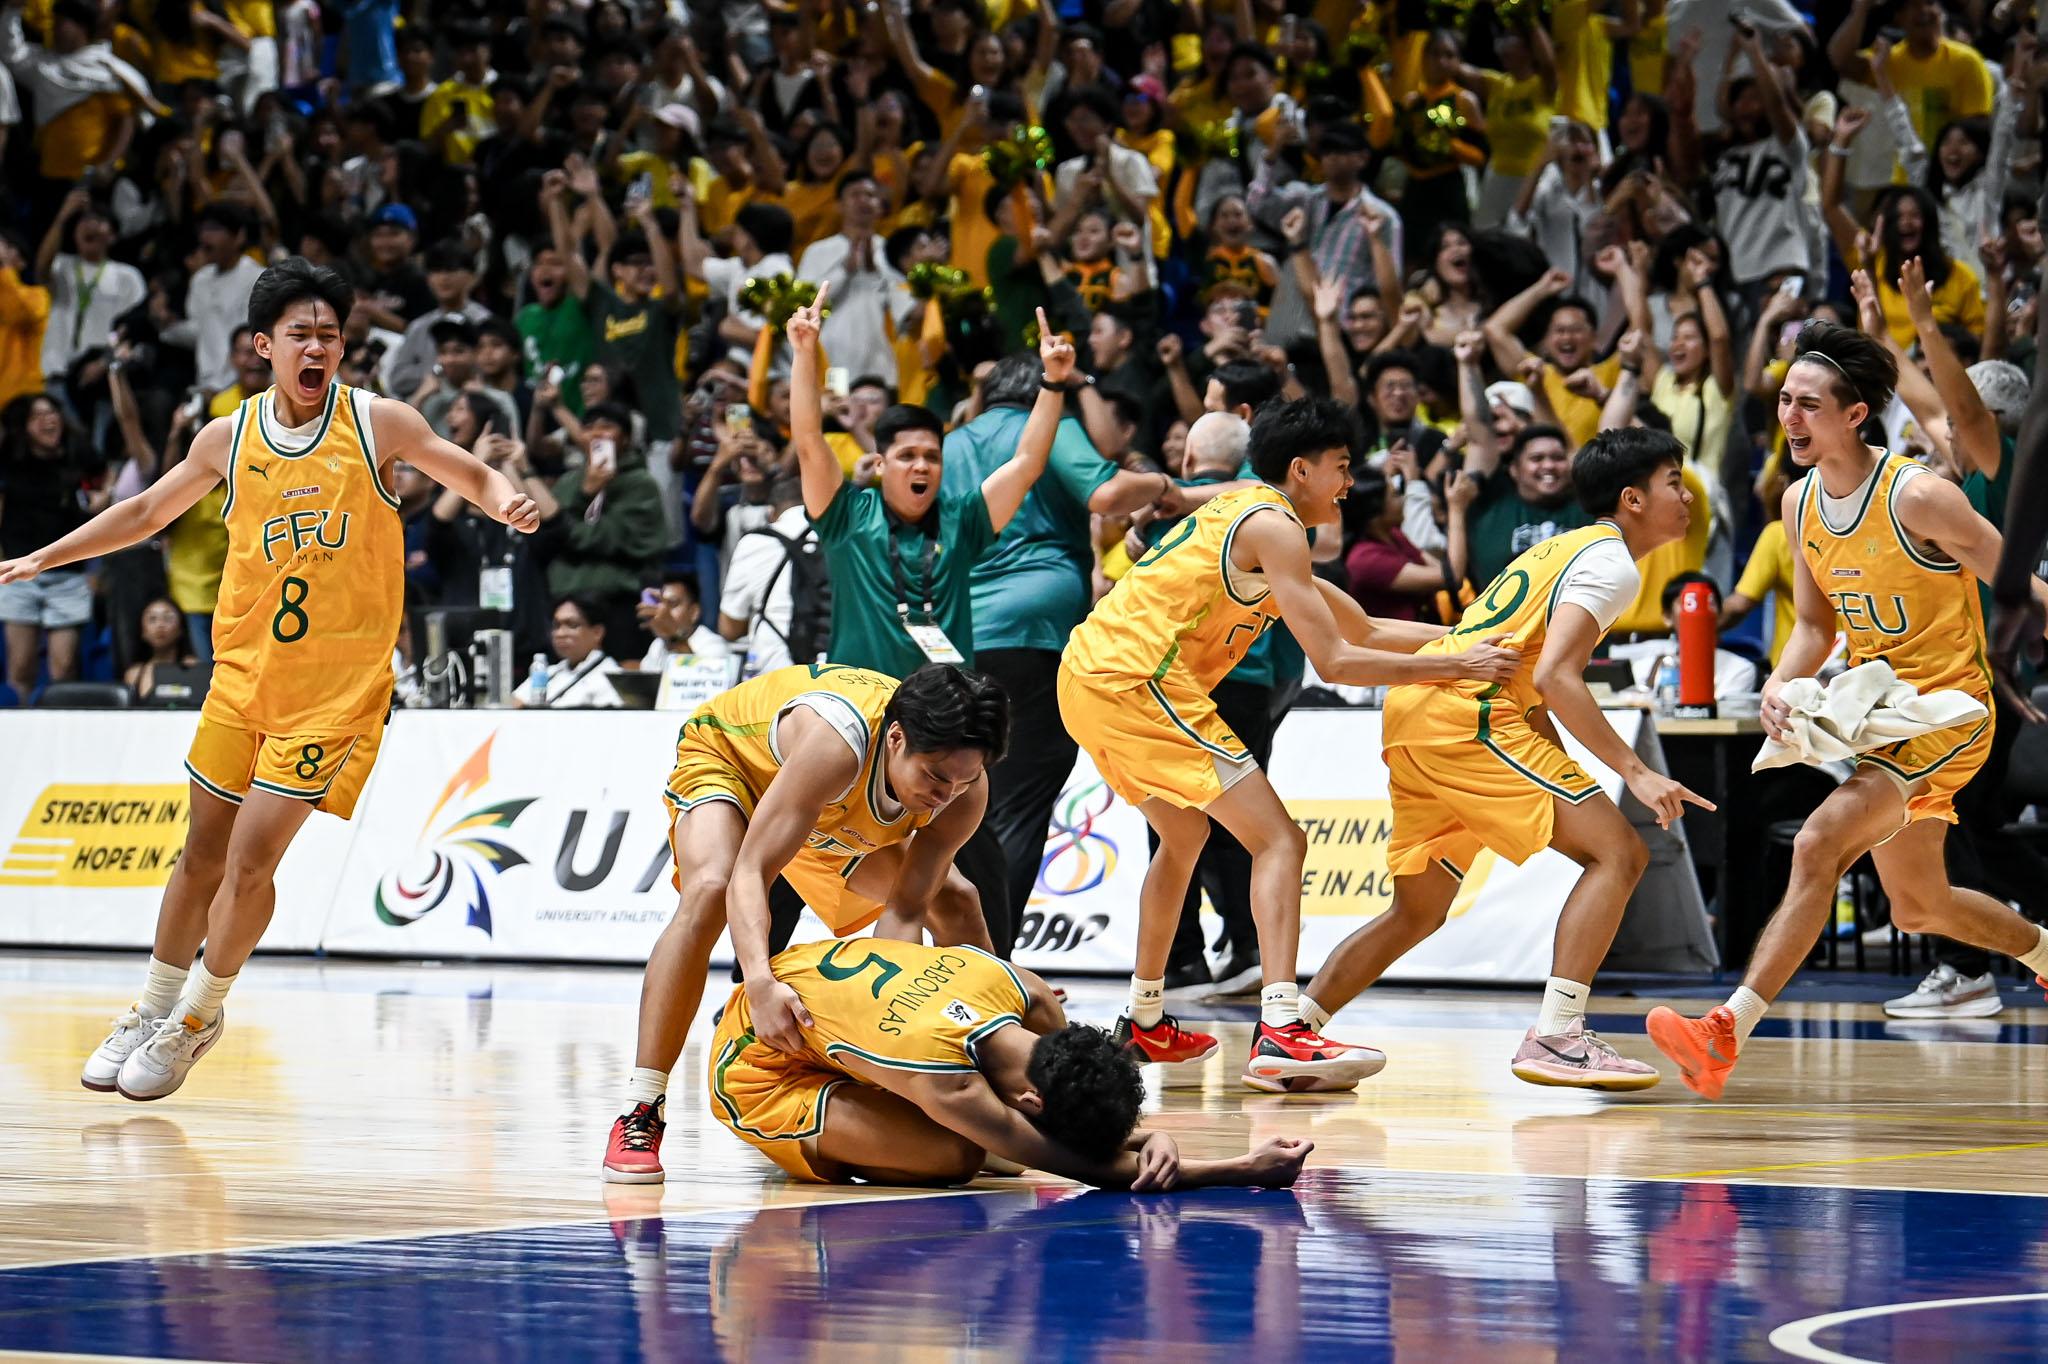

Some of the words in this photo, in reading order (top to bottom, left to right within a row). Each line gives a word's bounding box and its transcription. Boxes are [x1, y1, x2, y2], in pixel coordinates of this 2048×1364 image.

[272, 576, 309, 642] 8
[295, 744, 324, 780] 8
[40, 800, 154, 825] STRENGTH
[155, 800, 181, 824] IN
[1338, 818, 1370, 844] IN
[72, 846, 137, 871] HOPE
[137, 846, 164, 870] IN
[1320, 870, 1352, 896] IN
[535, 910, 607, 923] UNIVERSITY
[610, 910, 666, 923] ATHLETIC
[816, 941, 903, 1000] 5
[878, 954, 966, 1036] CABONILAS
